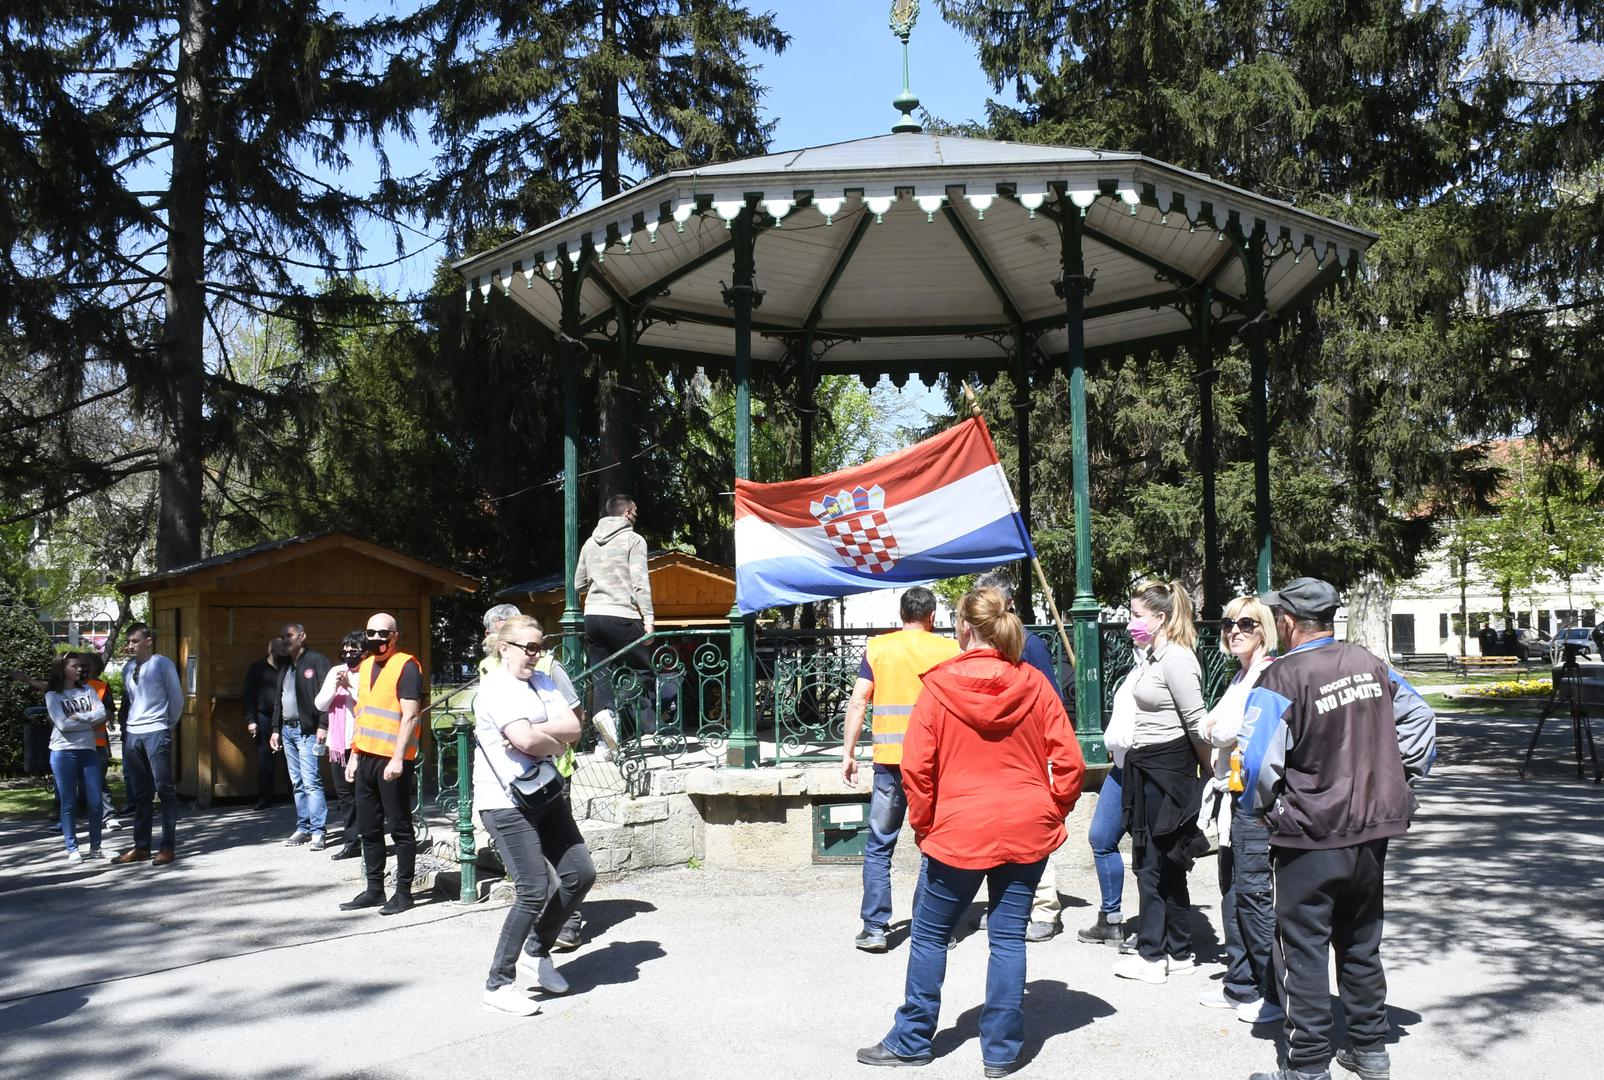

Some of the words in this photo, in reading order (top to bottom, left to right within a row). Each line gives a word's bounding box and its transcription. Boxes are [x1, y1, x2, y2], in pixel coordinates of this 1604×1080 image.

[1319, 676, 1352, 695] HOCKEY
[1353, 673, 1374, 683] CLUB
[1315, 694, 1338, 715] NO
[1338, 682, 1383, 706] LIMITS
